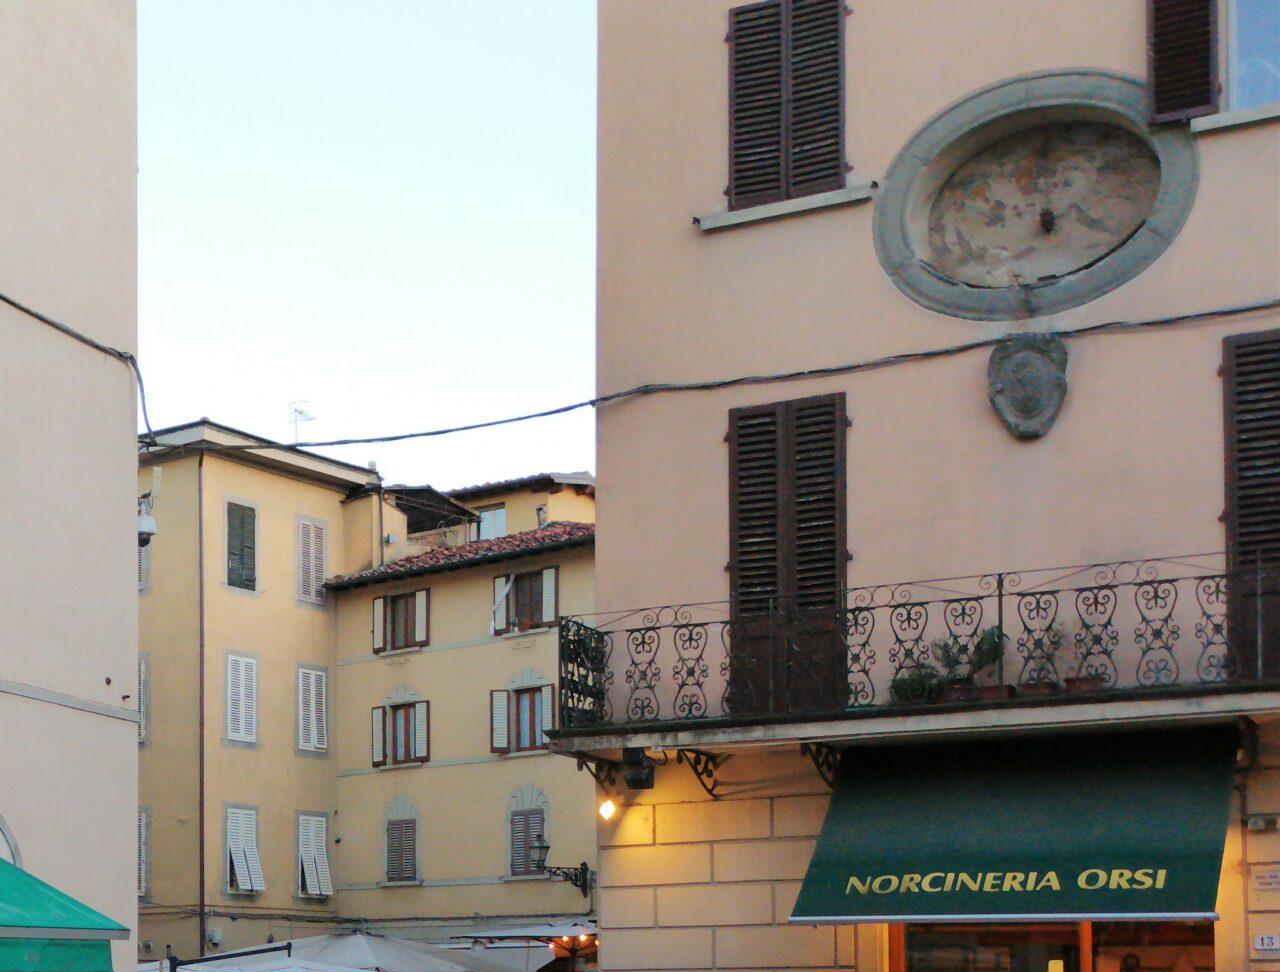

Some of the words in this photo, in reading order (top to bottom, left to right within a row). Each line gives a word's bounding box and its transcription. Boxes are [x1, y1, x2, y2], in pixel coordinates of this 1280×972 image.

[845, 871, 1062, 895] NORCINERIA
[1077, 868, 1168, 890] ORSI
[1260, 936, 1274, 947] 13
